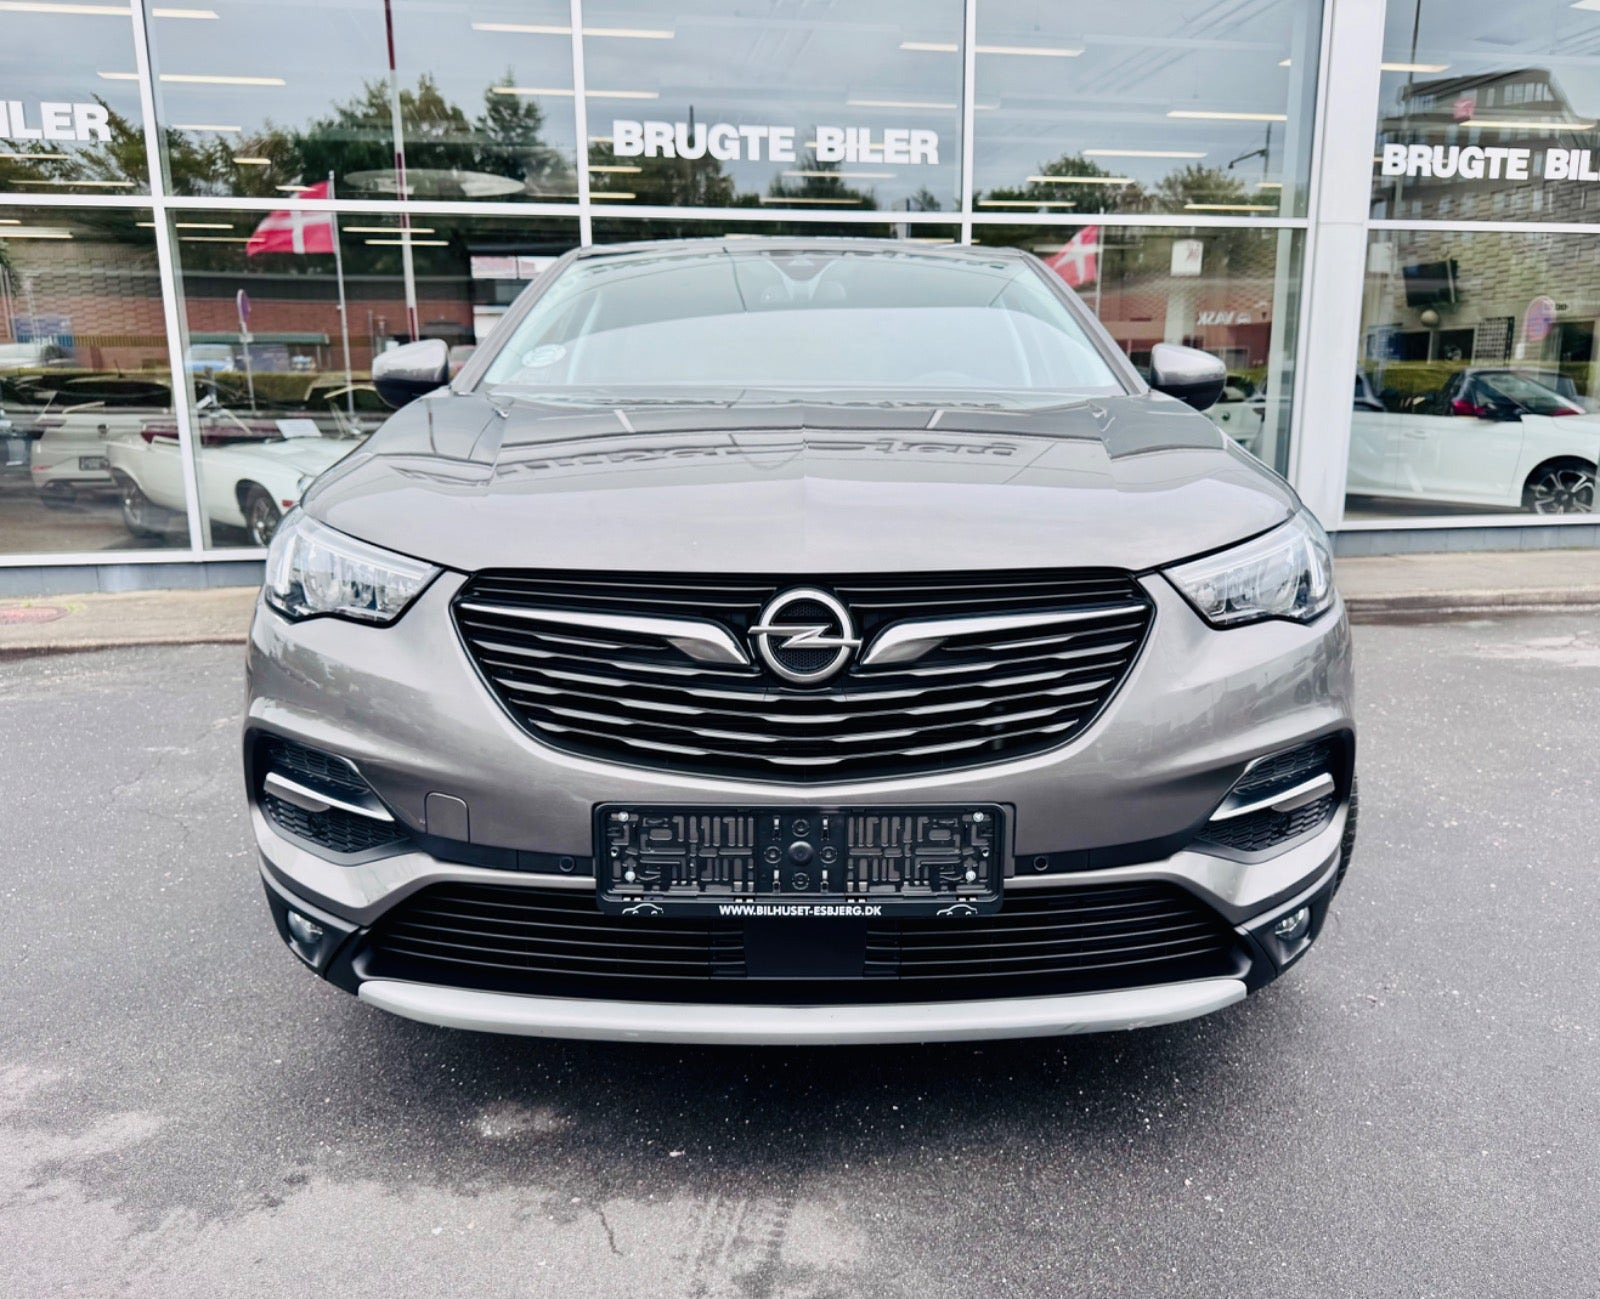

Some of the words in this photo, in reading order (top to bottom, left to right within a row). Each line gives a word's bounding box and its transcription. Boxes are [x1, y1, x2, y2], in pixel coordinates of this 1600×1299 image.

[612, 119, 797, 162] BRUGTE
[816, 125, 939, 165] BILER
[1381, 143, 1530, 180] BRUGTE
[718, 904, 883, 917] WWW.BILHUSET-ESBJERG.DK
